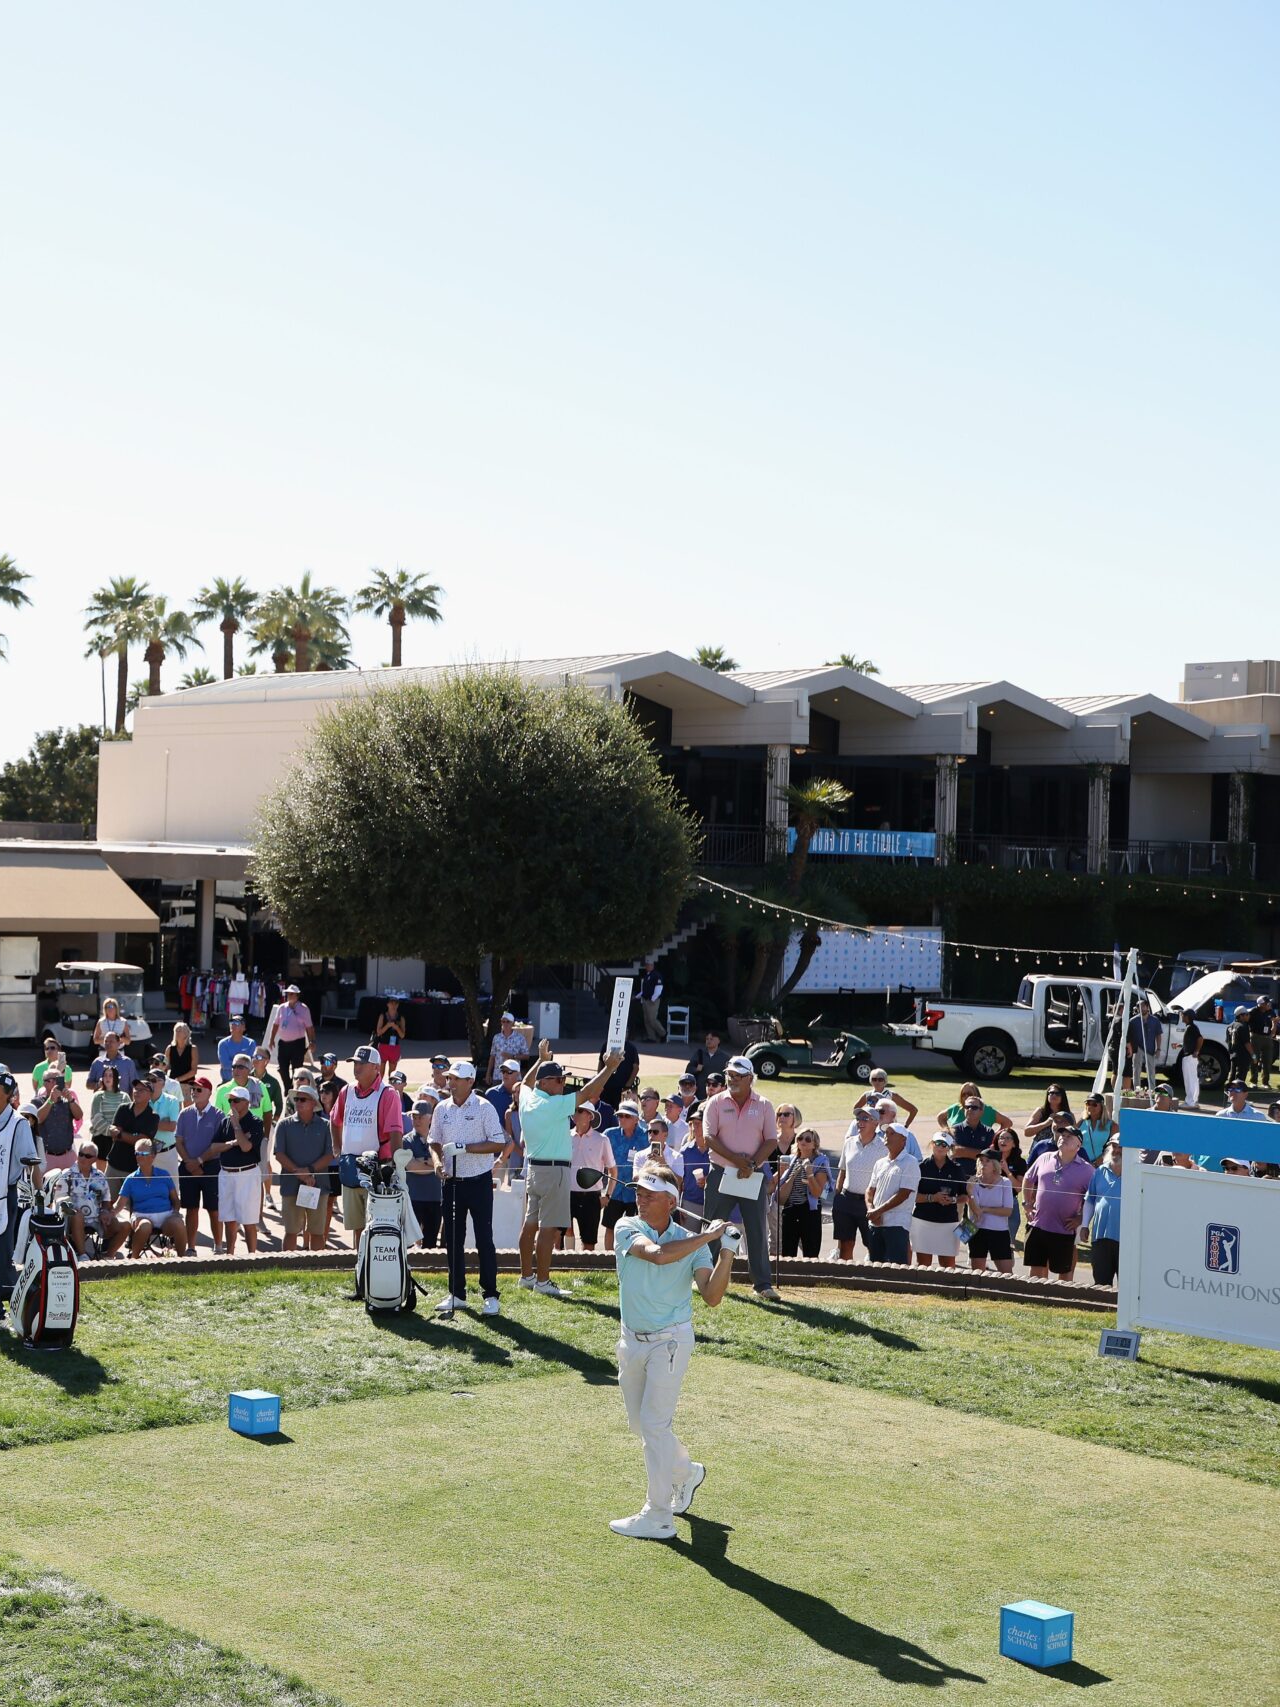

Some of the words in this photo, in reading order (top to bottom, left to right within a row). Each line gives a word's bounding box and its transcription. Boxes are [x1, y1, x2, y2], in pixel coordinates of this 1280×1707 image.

[615, 991, 625, 1035] QUIET
[373, 1254, 397, 1262] ALKER
[1209, 1235, 1220, 1268] TOUR
[1007, 1635, 1038, 1650] SCHWAB
